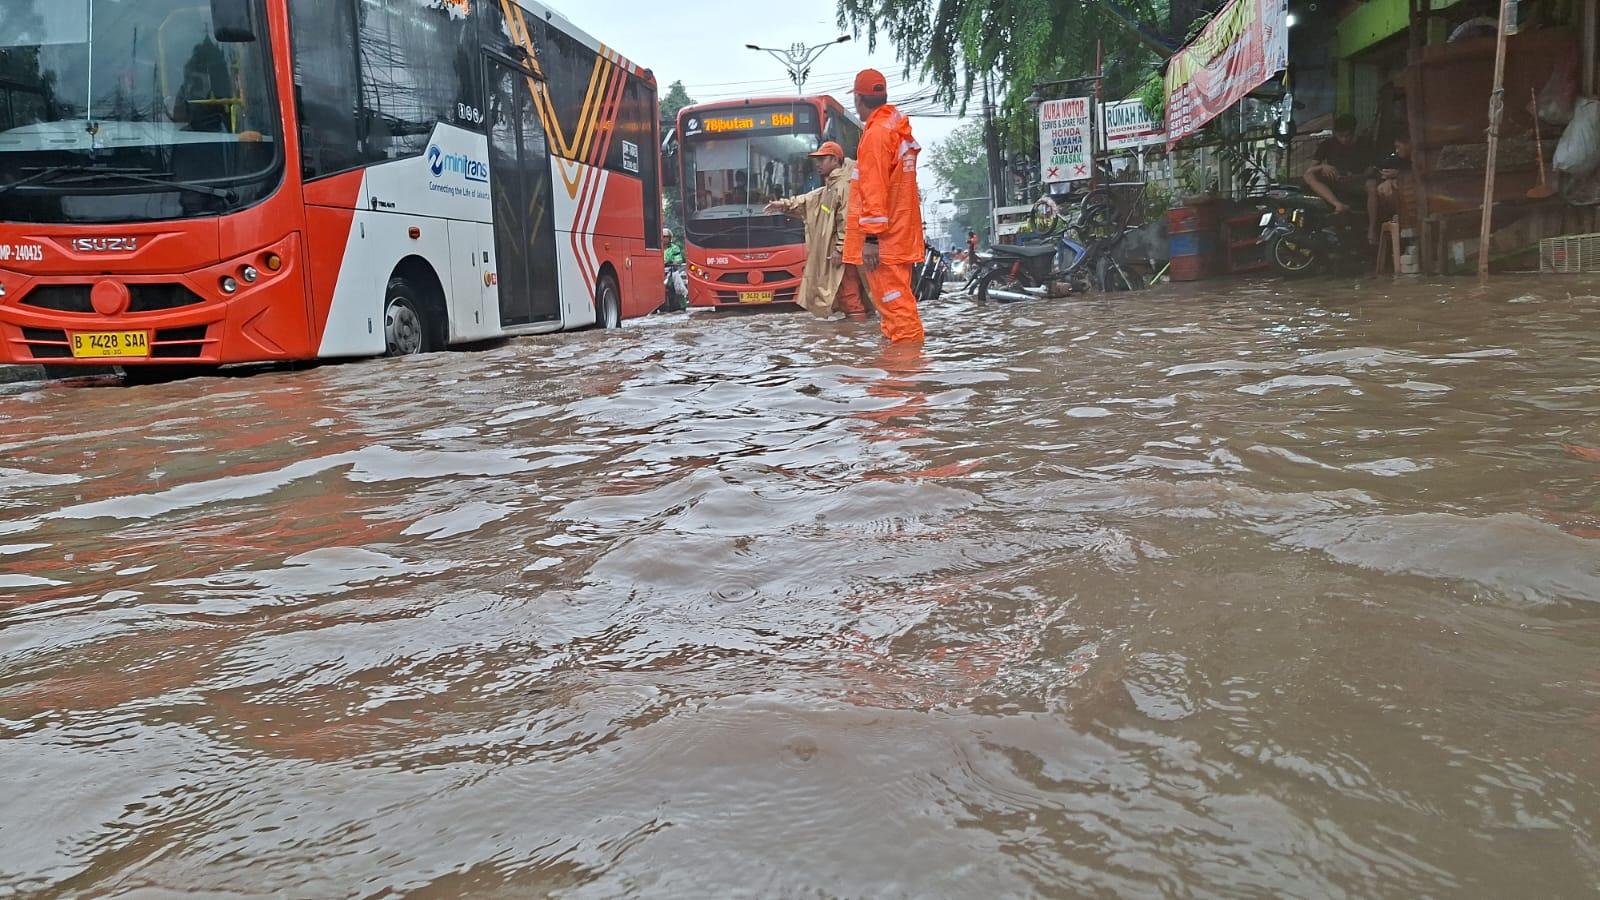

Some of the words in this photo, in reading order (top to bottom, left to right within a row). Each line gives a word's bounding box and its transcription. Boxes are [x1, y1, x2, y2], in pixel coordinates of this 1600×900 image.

[1043, 103, 1060, 120] AURA
[1061, 100, 1084, 118] MOTOR
[1062, 119, 1075, 128] SPARE
[1107, 106, 1135, 128] RUMAH
[1051, 128, 1080, 138] HONDA
[1108, 124, 1150, 133] INDONESIA
[1052, 136, 1082, 146] YAMAHA
[1053, 145, 1082, 155] SUZUKI
[444, 153, 488, 179] minitrans
[1050, 154, 1083, 166] KAWASAKI
[429, 181, 454, 197] Connecting
[463, 187, 471, 197] Life
[72, 237, 136, 251] ISUZU
[75, 335, 82, 349] B
[89, 335, 118, 350] 7428
[125, 334, 145, 347] SAA
